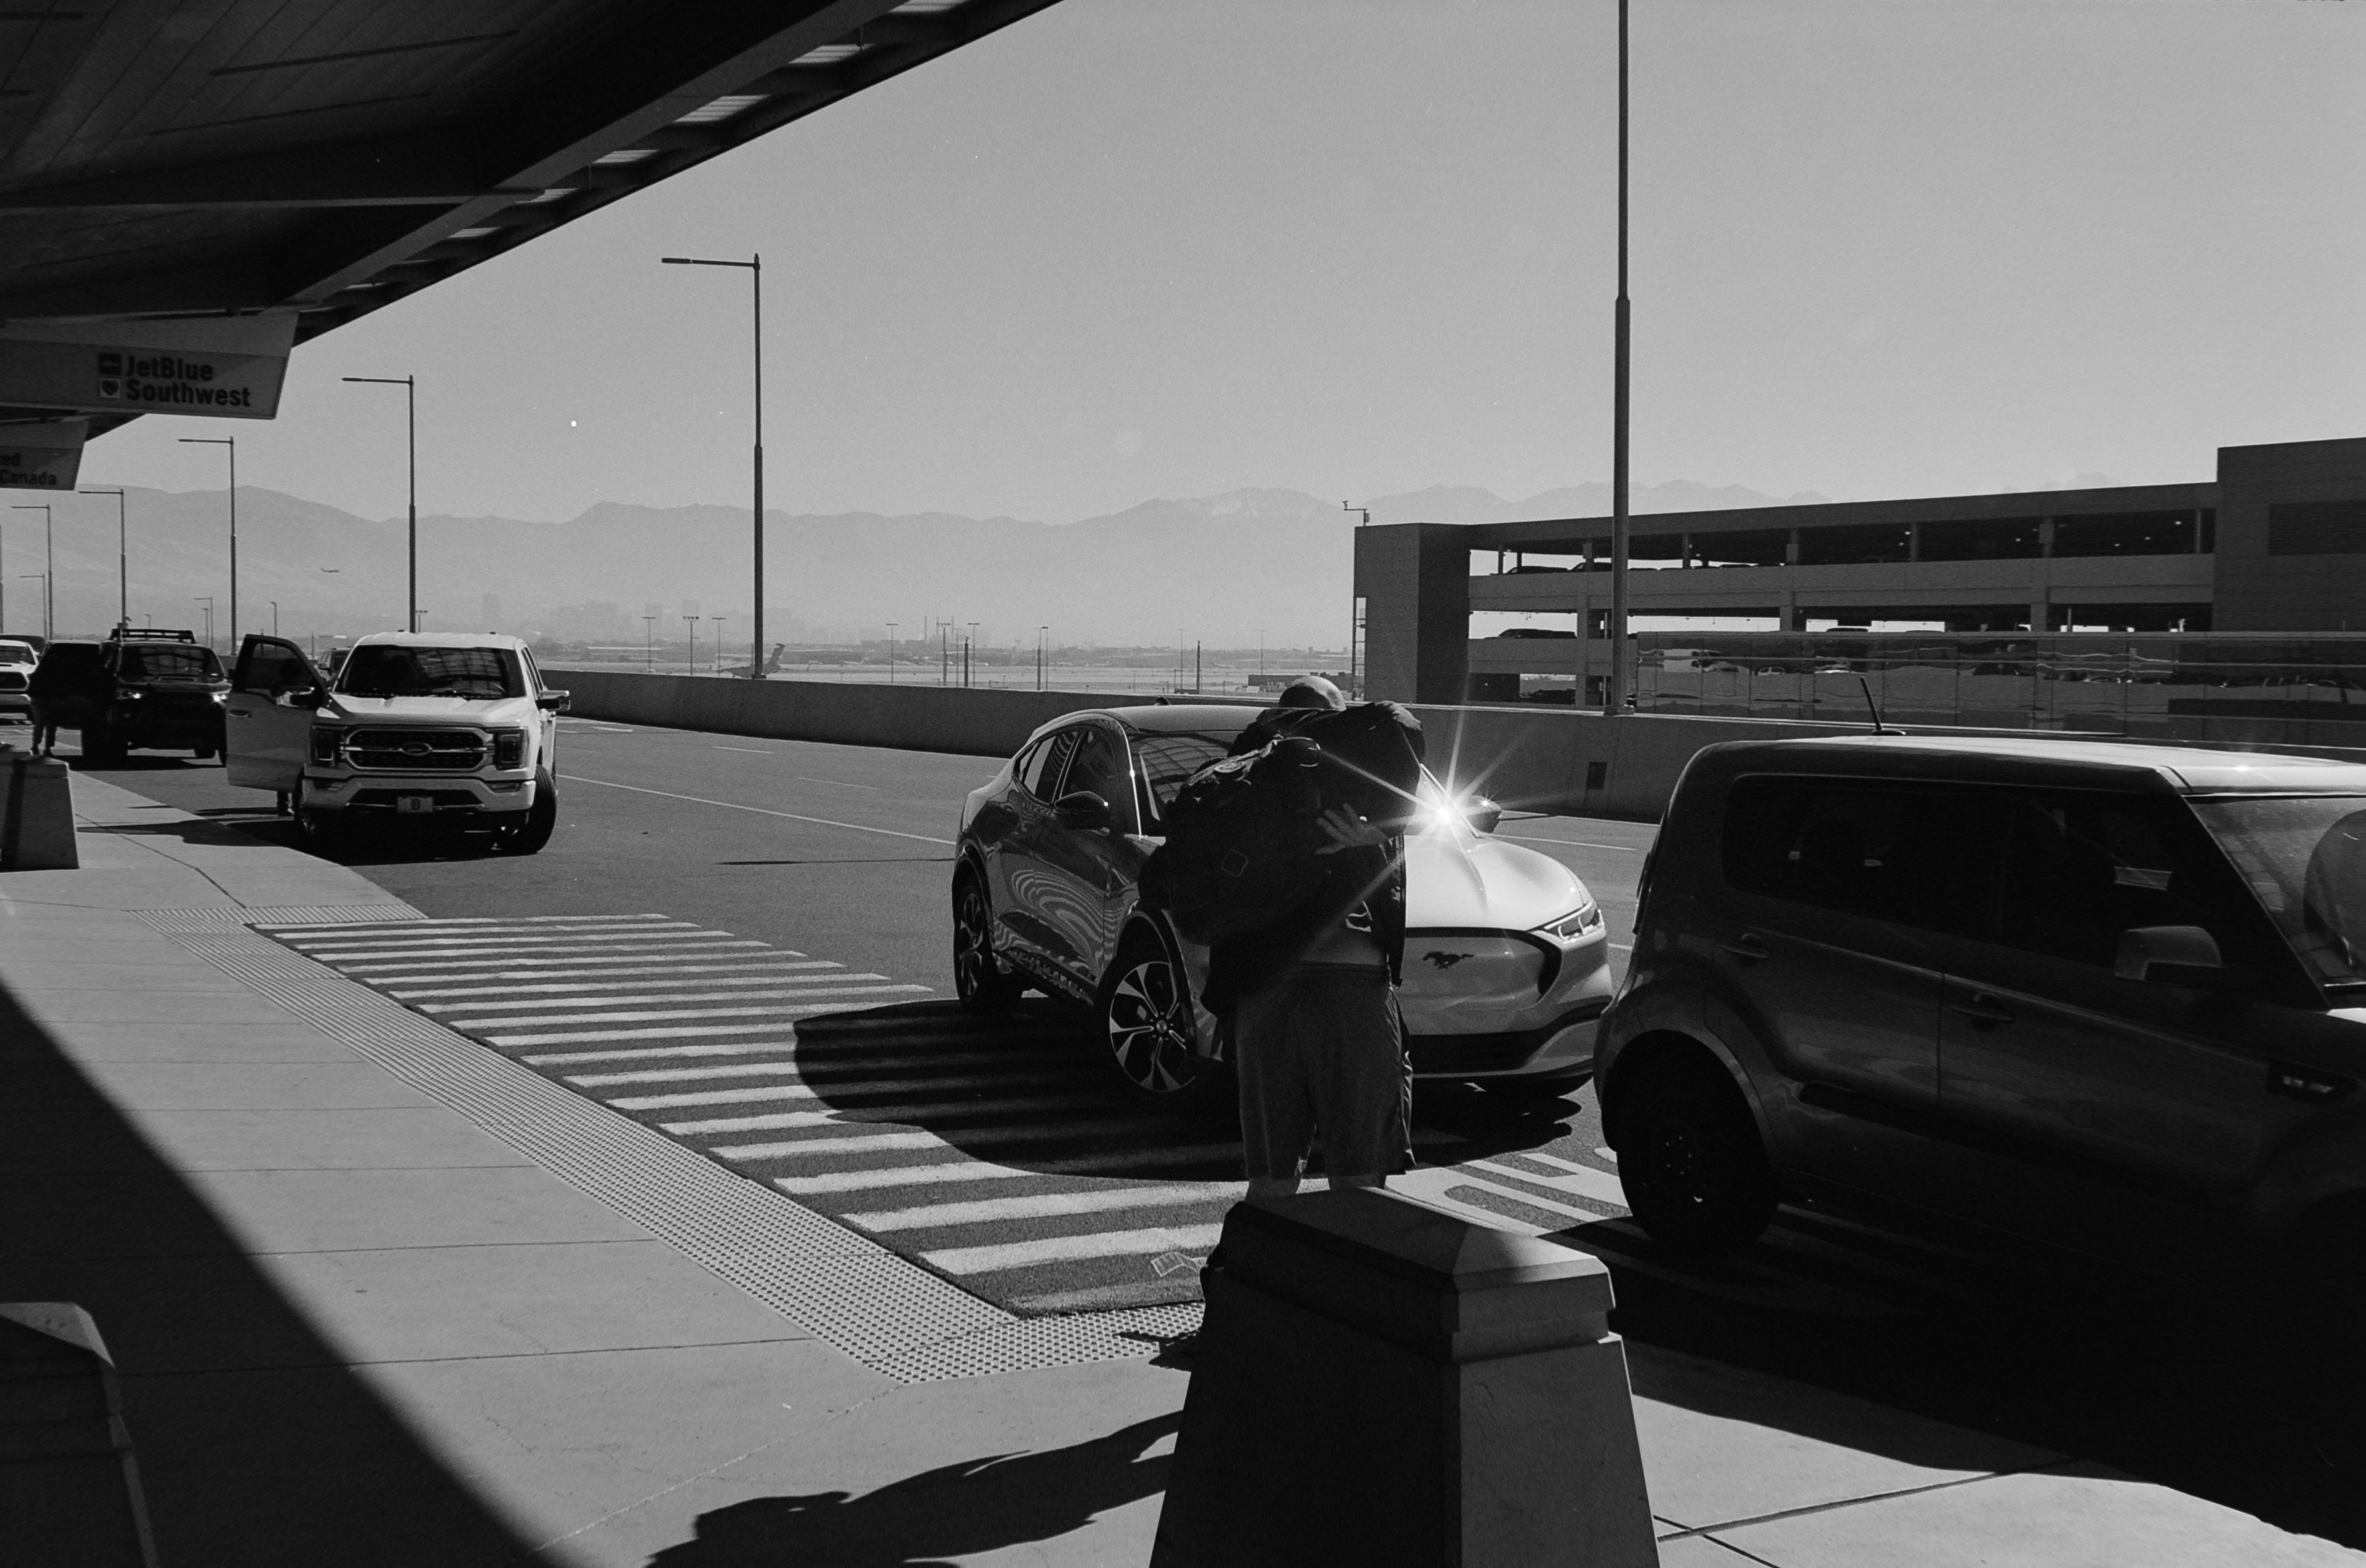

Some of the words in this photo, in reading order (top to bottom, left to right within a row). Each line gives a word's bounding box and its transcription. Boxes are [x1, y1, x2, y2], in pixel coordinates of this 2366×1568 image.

[126, 355, 213, 381] JetBlue
[126, 378, 250, 407] Southwest
[0, 469, 57, 485] Canada
